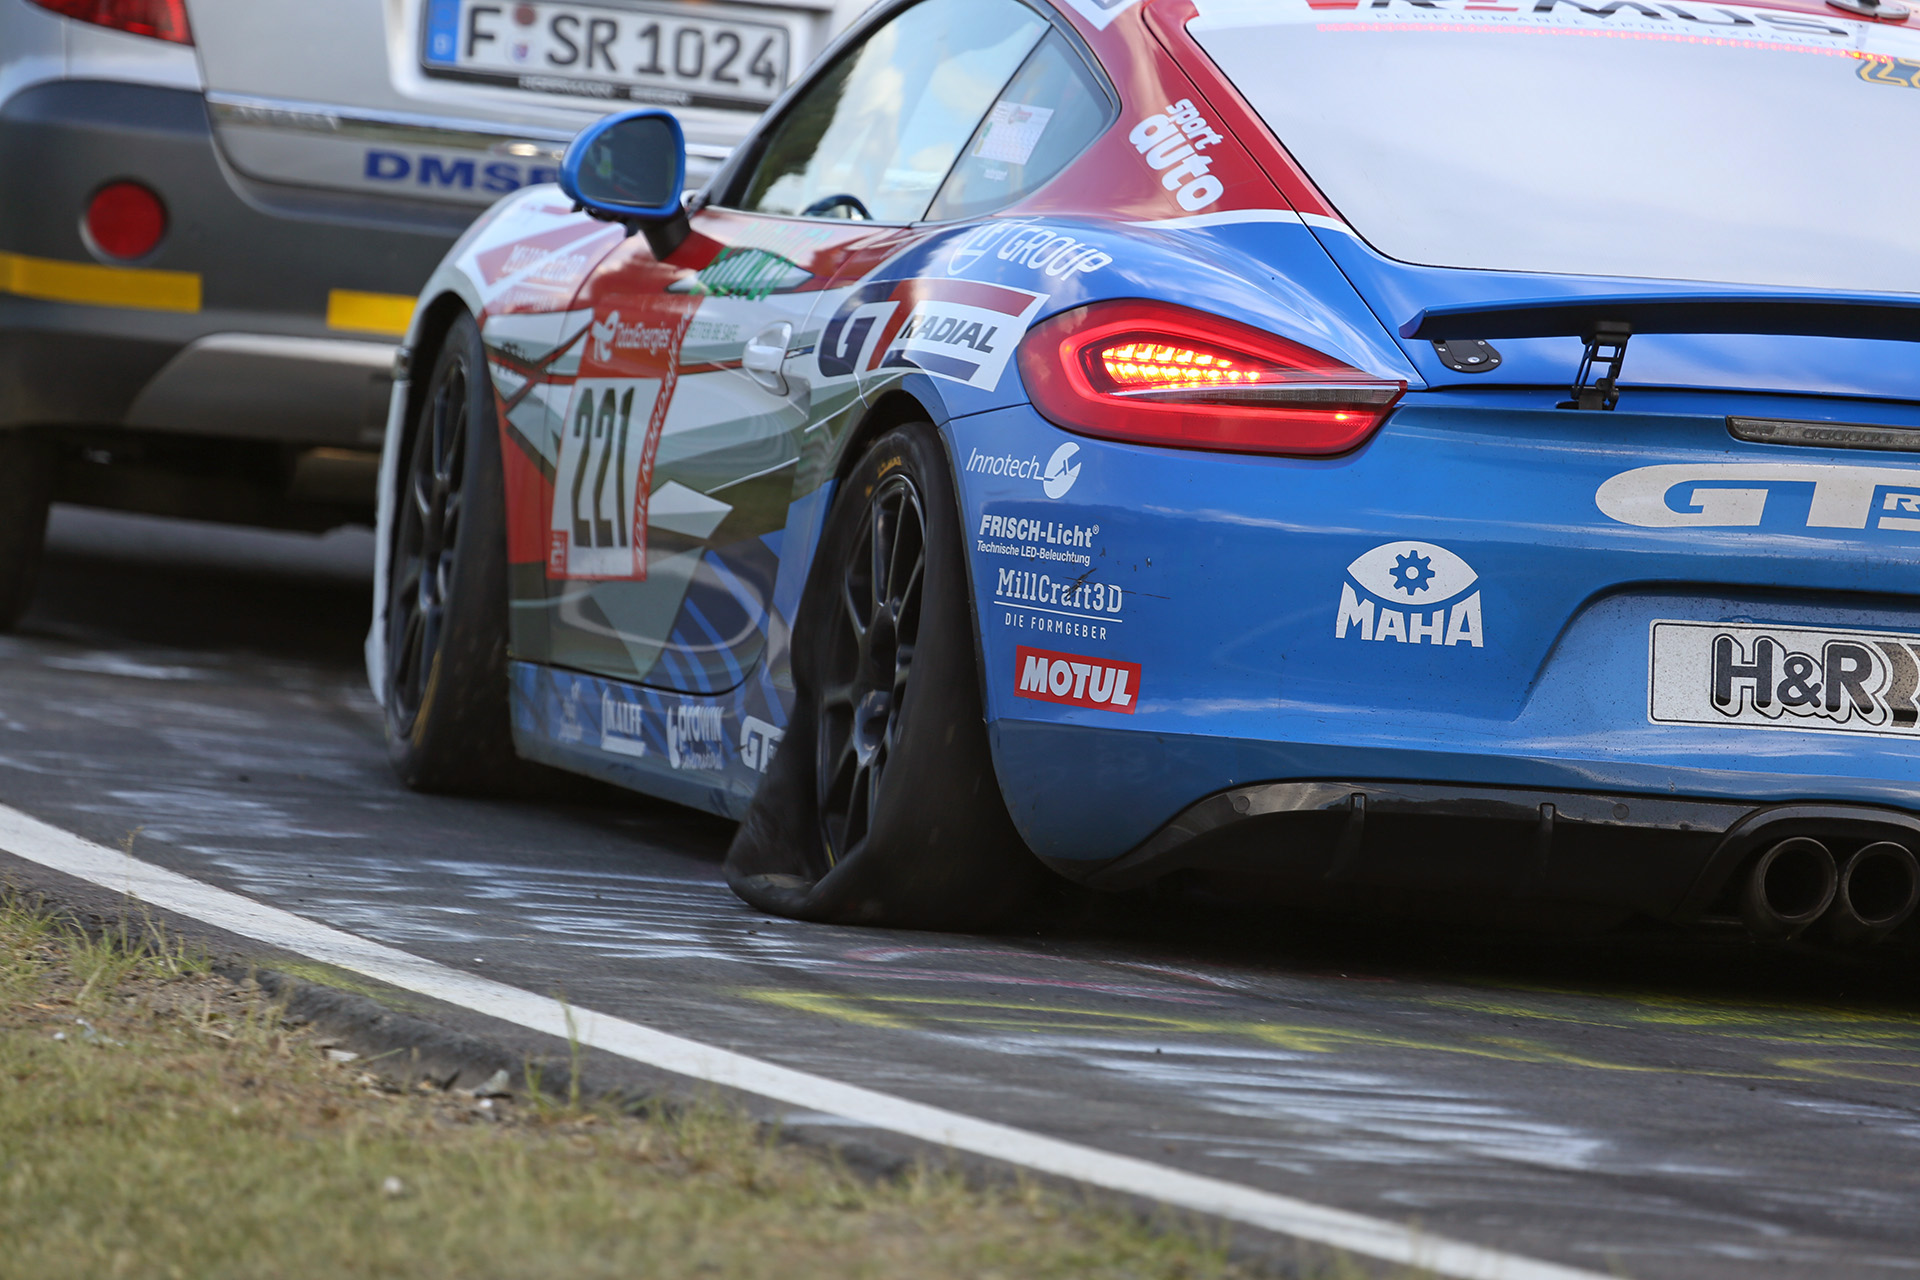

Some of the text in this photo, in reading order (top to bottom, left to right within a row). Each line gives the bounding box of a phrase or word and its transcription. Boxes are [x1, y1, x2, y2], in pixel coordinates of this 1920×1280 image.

[465, 6, 777, 89] F SR 1024
[1165, 98, 1225, 151] sport
[1128, 113, 1225, 212] auto
[996, 227, 1114, 282] GROUP
[899, 313, 999, 355] RADIAL
[570, 386, 635, 548] 221
[966, 447, 1041, 480] Innotech
[976, 539, 1091, 567] Technische LED-Beleuchtung
[995, 567, 1123, 613] MillCraft3D
[1335, 581, 1484, 648] MAHA
[1004, 612, 1107, 641] DIE FORMGEBER
[1019, 655, 1132, 706] MOTUL
[1711, 632, 1888, 727] H&R
